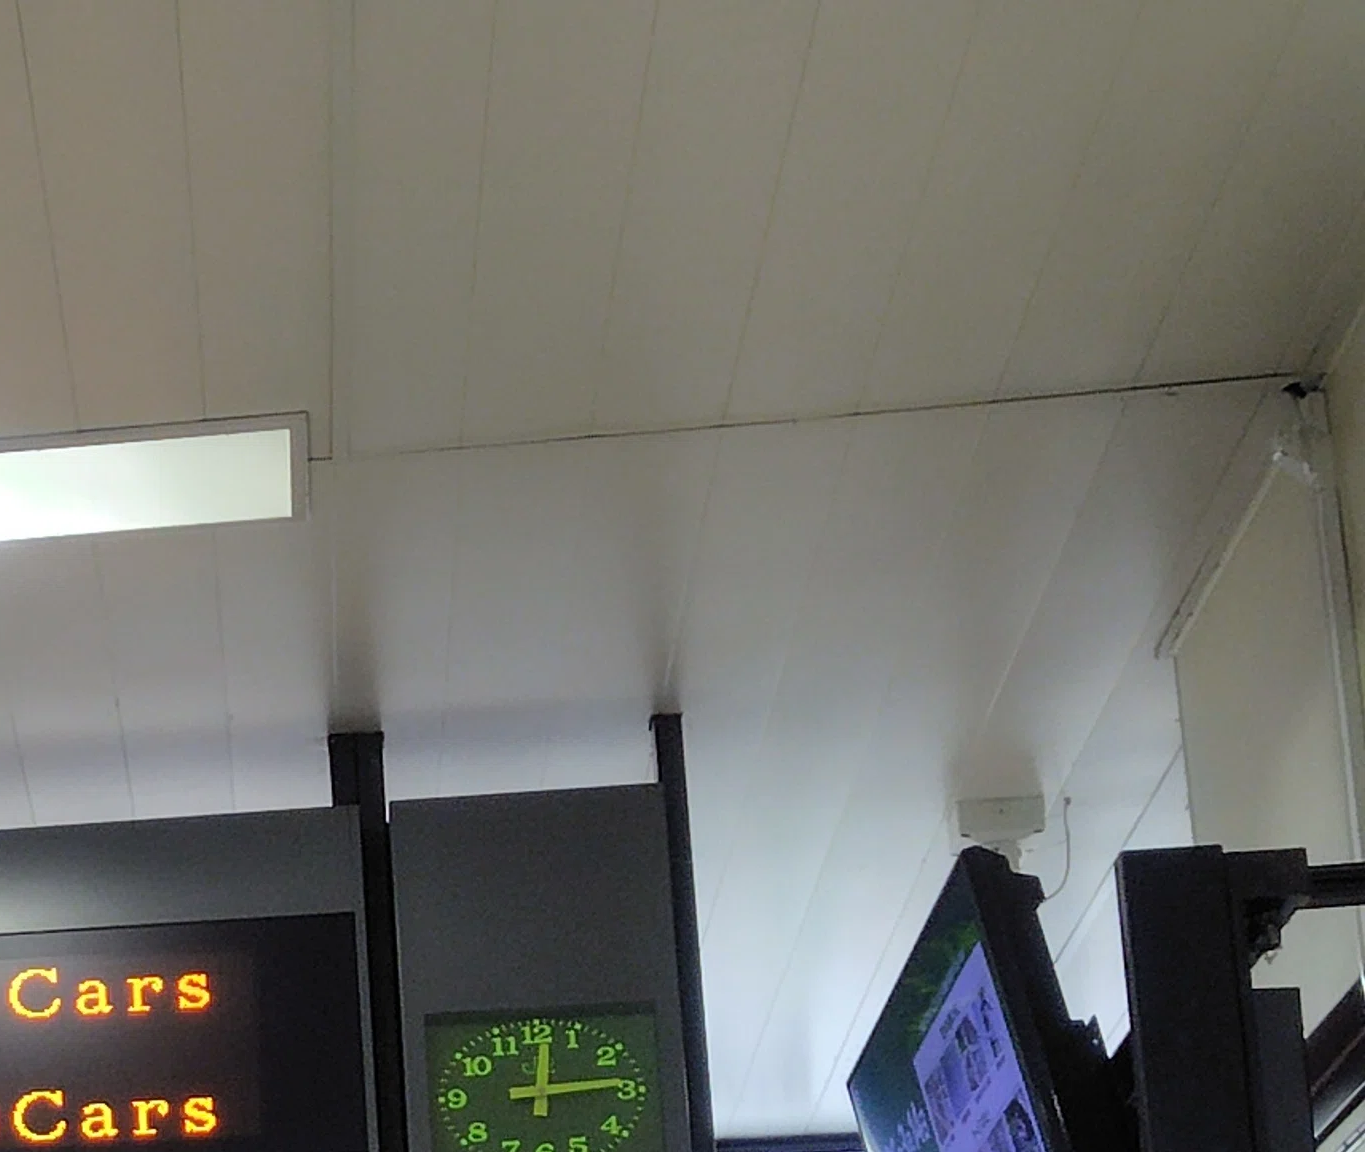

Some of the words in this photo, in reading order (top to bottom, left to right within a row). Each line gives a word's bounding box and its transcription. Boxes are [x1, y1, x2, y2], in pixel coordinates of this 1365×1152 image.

[521, 1025, 553, 1044] 12
[565, 1029, 579, 1048] 1
[492, 1036, 519, 1056] 11
[597, 1046, 617, 1066] 2
[462, 1056, 492, 1077] 10
[447, 1088, 467, 1109] 9
[618, 1080, 637, 1100] 3
[468, 1122, 488, 1142] 8
[600, 1115, 623, 1136] 4
